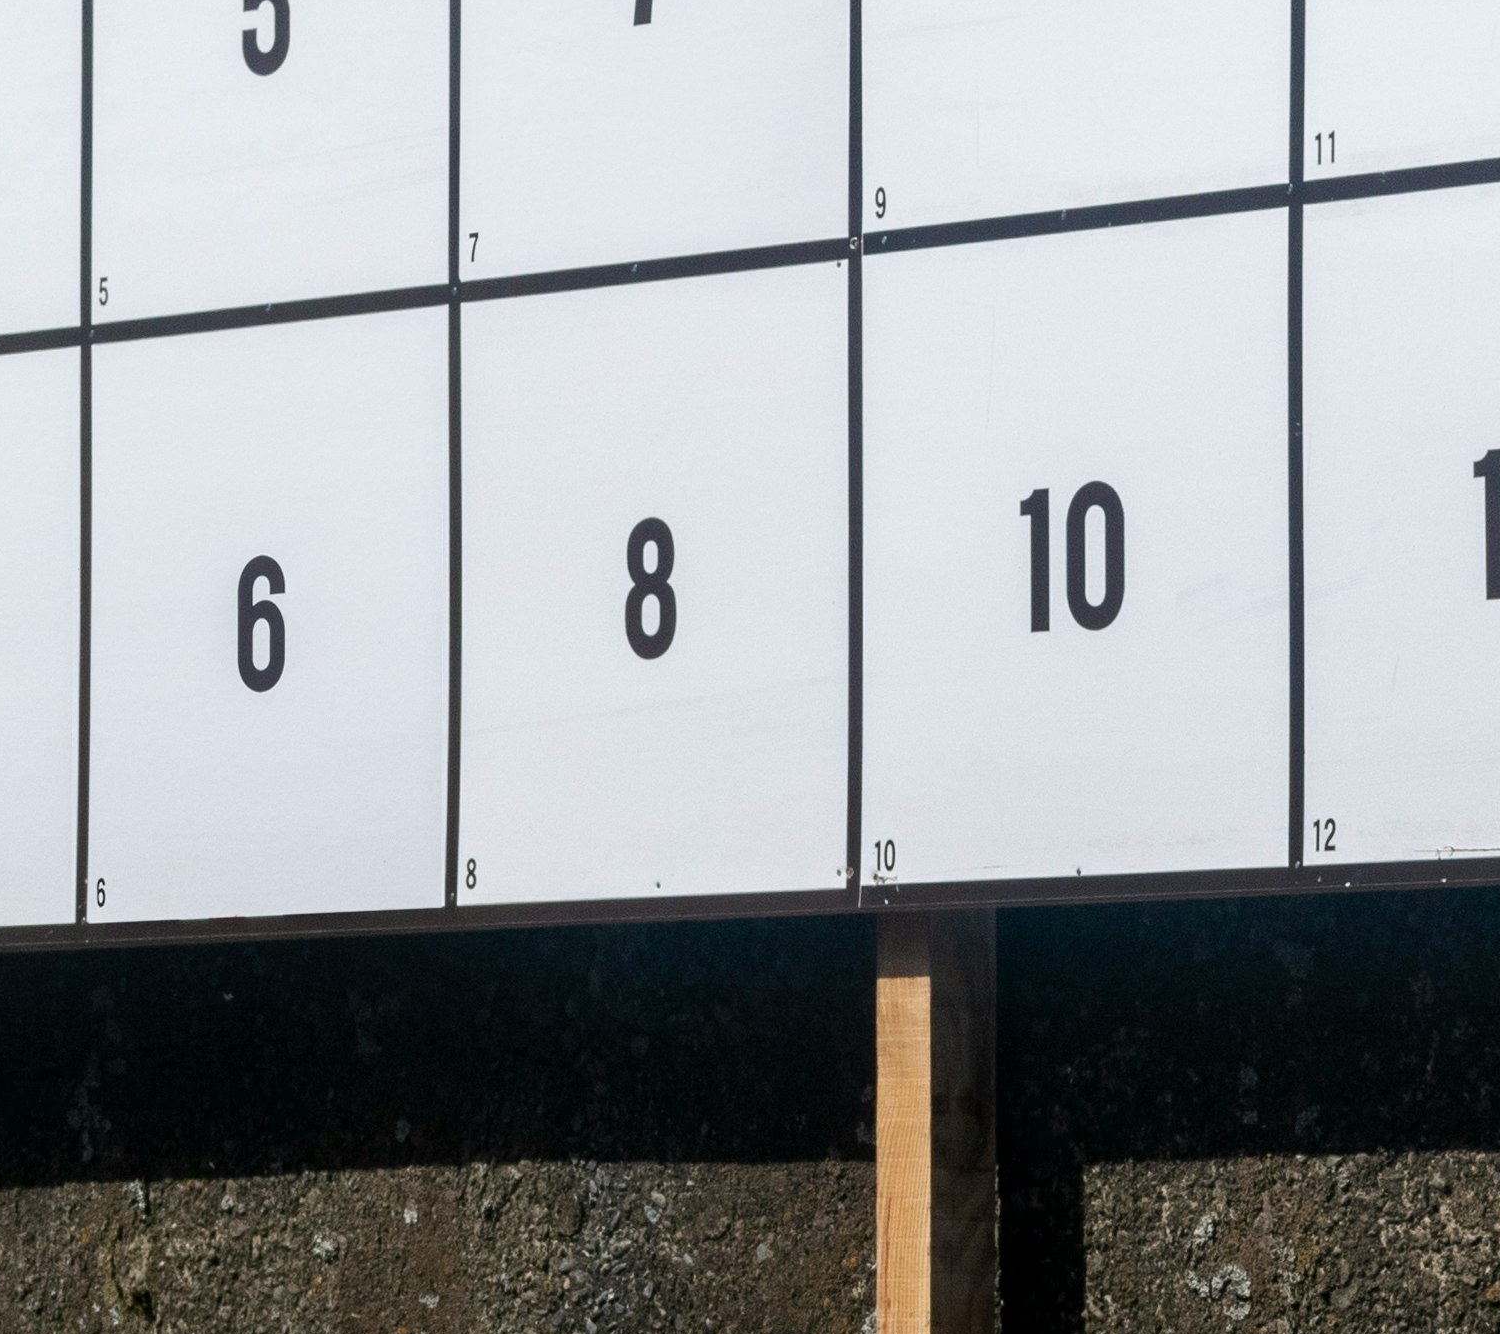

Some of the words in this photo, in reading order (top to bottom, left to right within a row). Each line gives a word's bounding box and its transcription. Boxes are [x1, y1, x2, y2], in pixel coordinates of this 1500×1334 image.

[1314, 130, 1335, 166] 11
[874, 186, 887, 220] 9
[468, 231, 479, 263] 7
[98, 276, 109, 307] 5
[1020, 481, 1125, 633] 10
[625, 517, 677, 660] 8
[237, 555, 285, 693] 6
[1312, 817, 1337, 853] 12
[874, 838, 896, 872] 10
[465, 857, 477, 890] 8
[96, 877, 107, 908] 6
